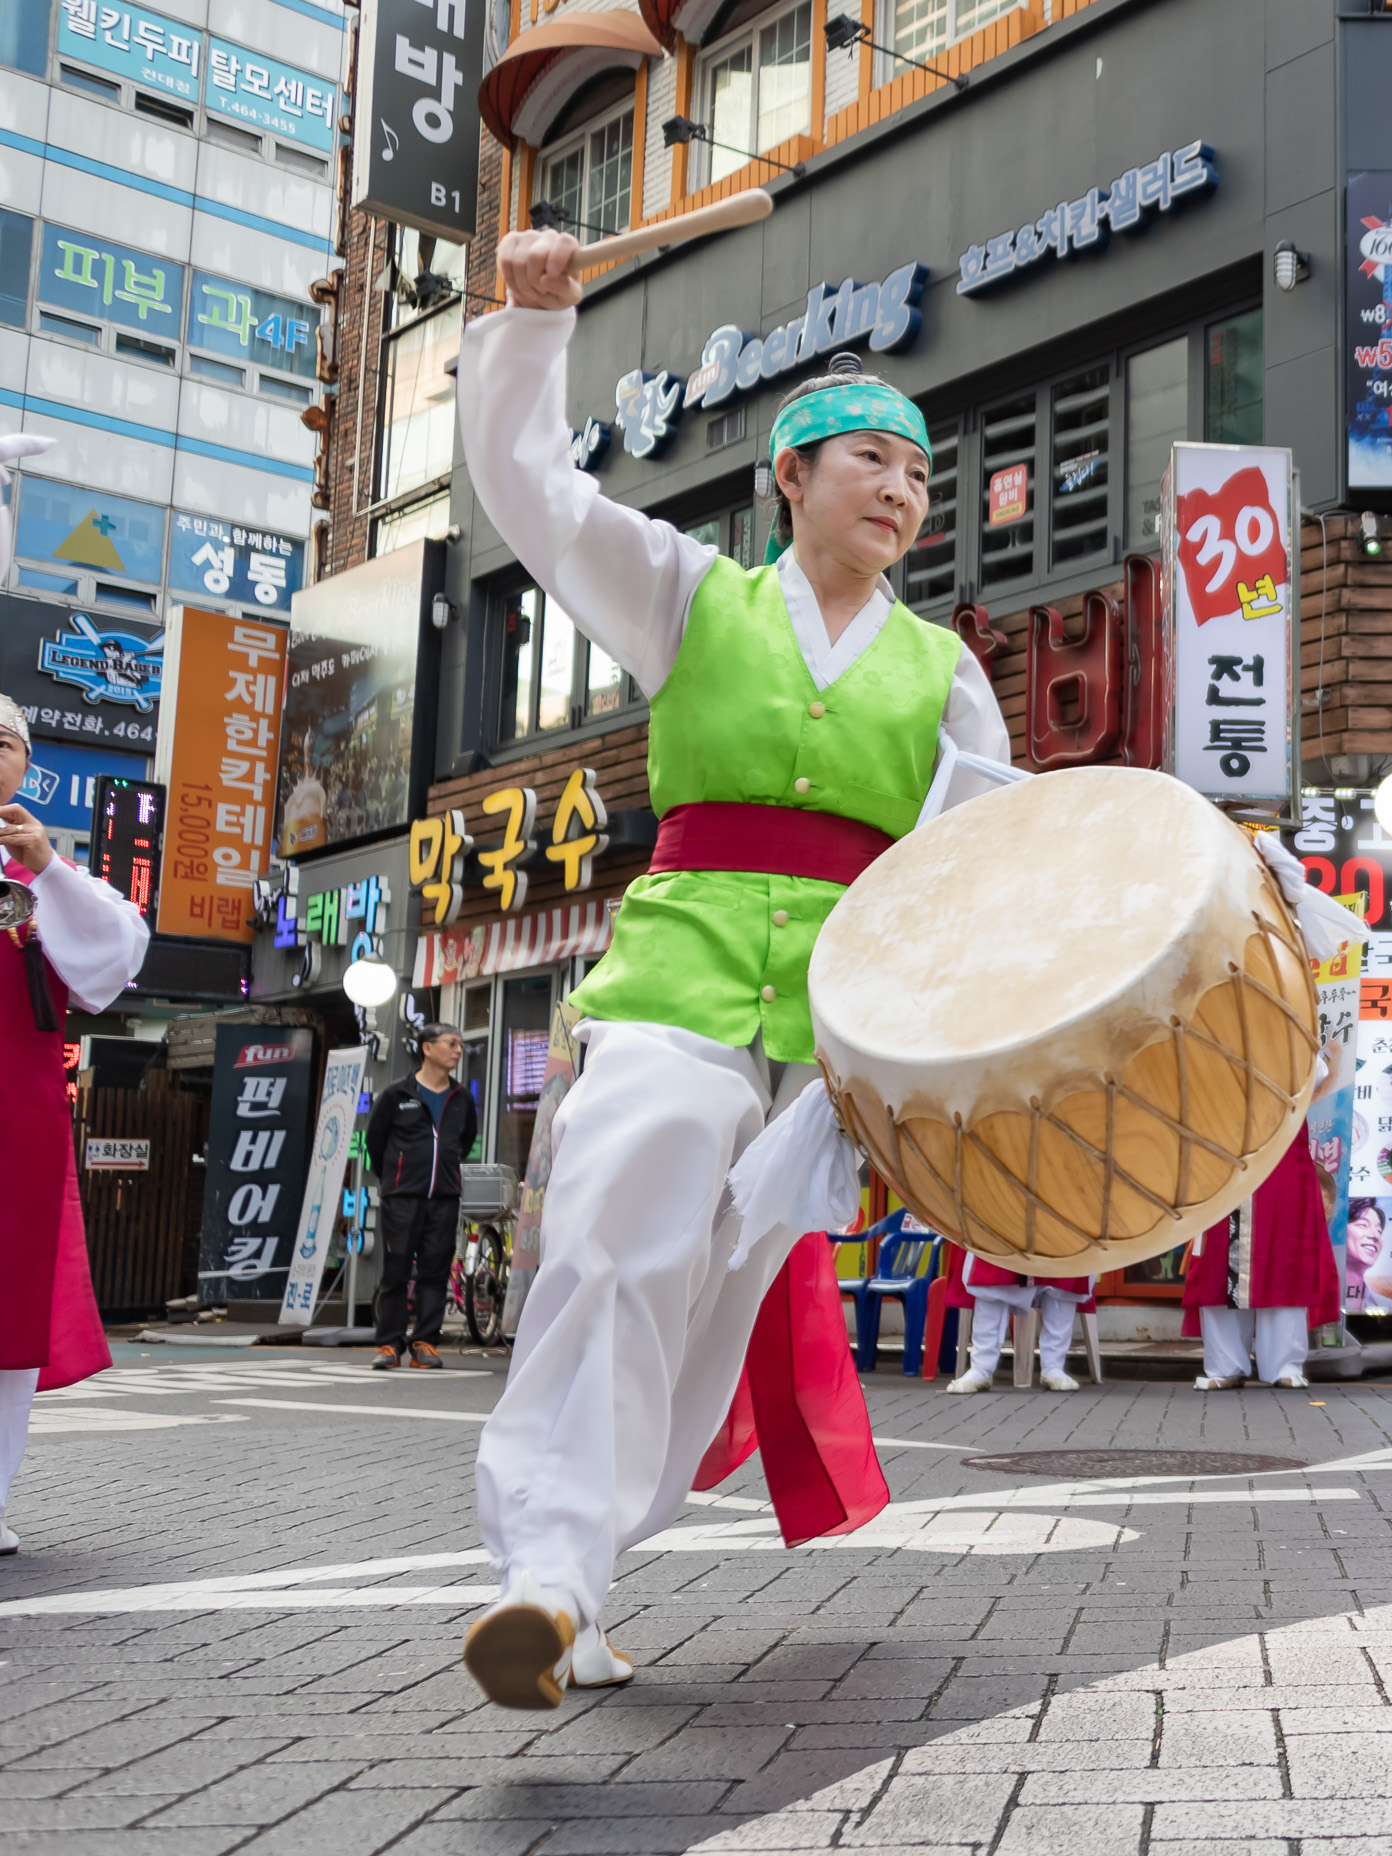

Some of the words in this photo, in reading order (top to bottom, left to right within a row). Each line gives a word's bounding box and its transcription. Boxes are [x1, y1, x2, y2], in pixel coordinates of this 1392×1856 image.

[141, 66, 191, 96] 건대점
[210, 50, 335, 128] 탈모센터
[219, 96, 296, 135] T.464-3455
[430, 181, 462, 214] B1
[255, 311, 310, 354] 4F
[701, 260, 919, 409] Beerking
[993, 469, 1023, 494] 흡연실
[175, 514, 224, 542] 주민과
[232, 527, 294, 556] 함께하는
[50, 649, 108, 672] LEGEND
[1202, 654, 1268, 779] 전통
[173, 782, 214, 882] 15,000원
[409, 767, 605, 925] 막국수
[273, 874, 385, 966] 노래방
[243, 1044, 290, 1063] fun
[1353, 1084, 1372, 1101] 비
[101, 1142, 149, 1159] 화장실
[223, 1076, 288, 1282] 편비어킹
